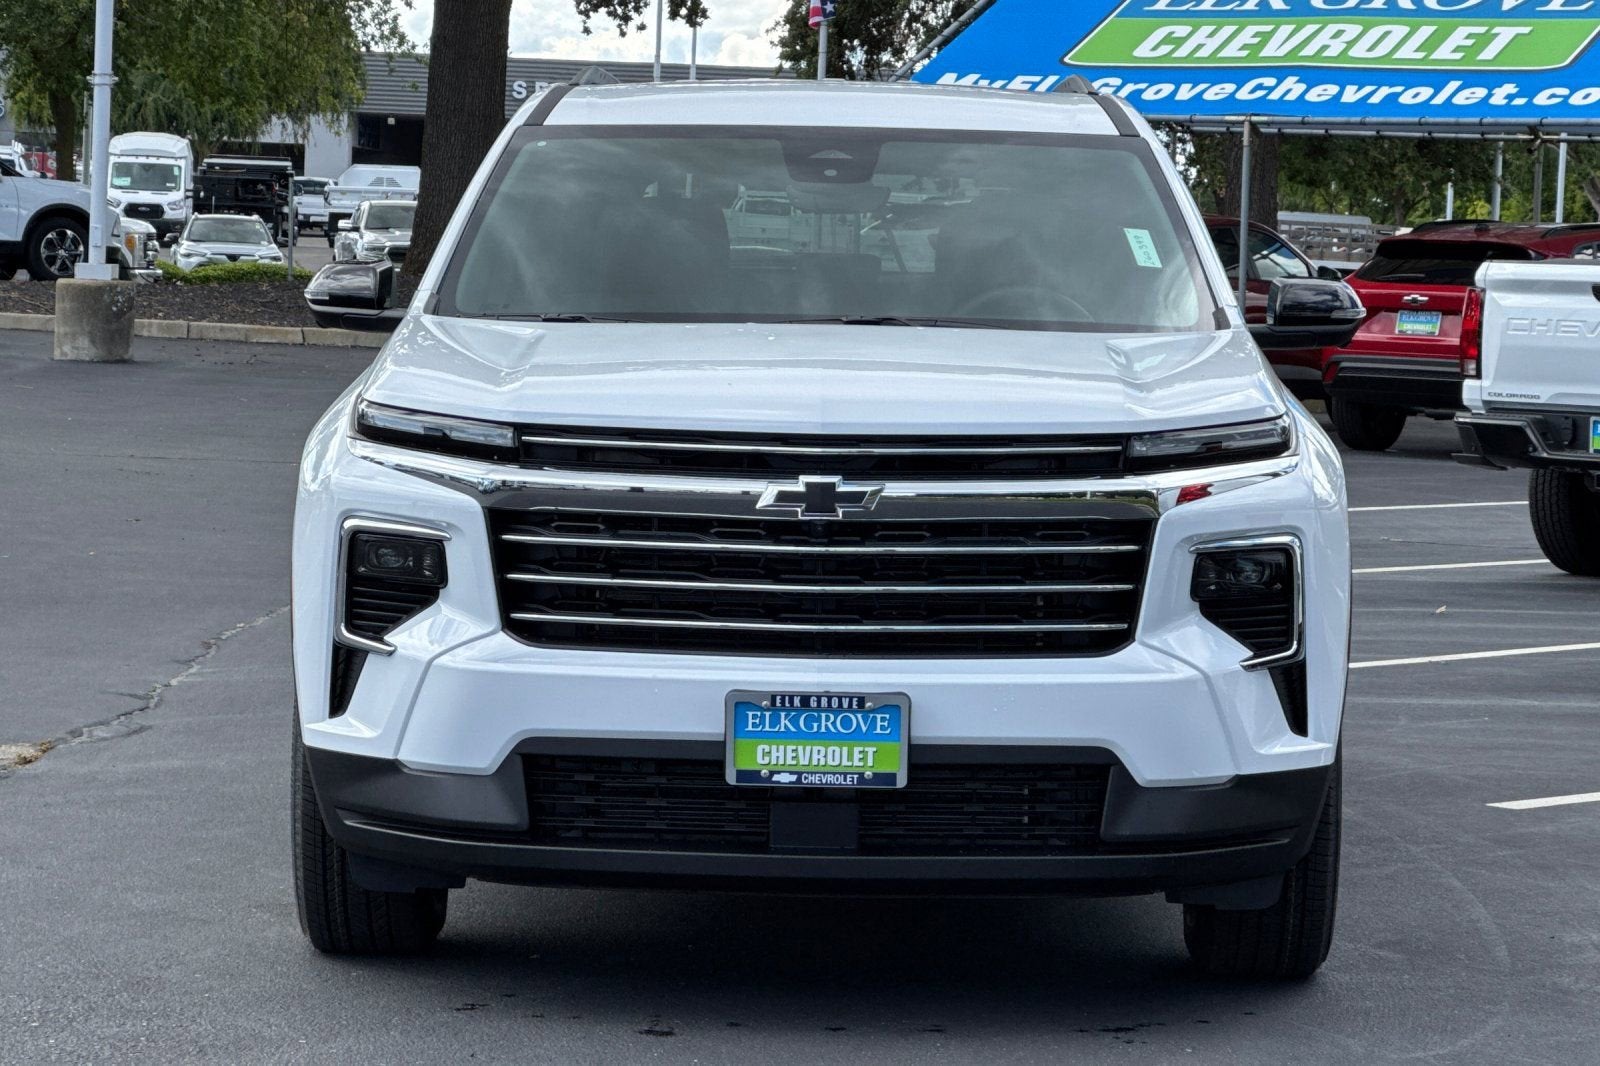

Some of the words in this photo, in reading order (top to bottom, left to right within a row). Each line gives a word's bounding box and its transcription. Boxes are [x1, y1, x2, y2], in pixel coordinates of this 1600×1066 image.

[1132, 23, 1533, 60] CHEVROLET
[1488, 391, 1541, 400] COLORADO
[776, 695, 801, 707] ELK
[810, 696, 859, 709] GROVE
[756, 744, 877, 767] CHEVROLET
[801, 773, 859, 785] CHEVROLET
